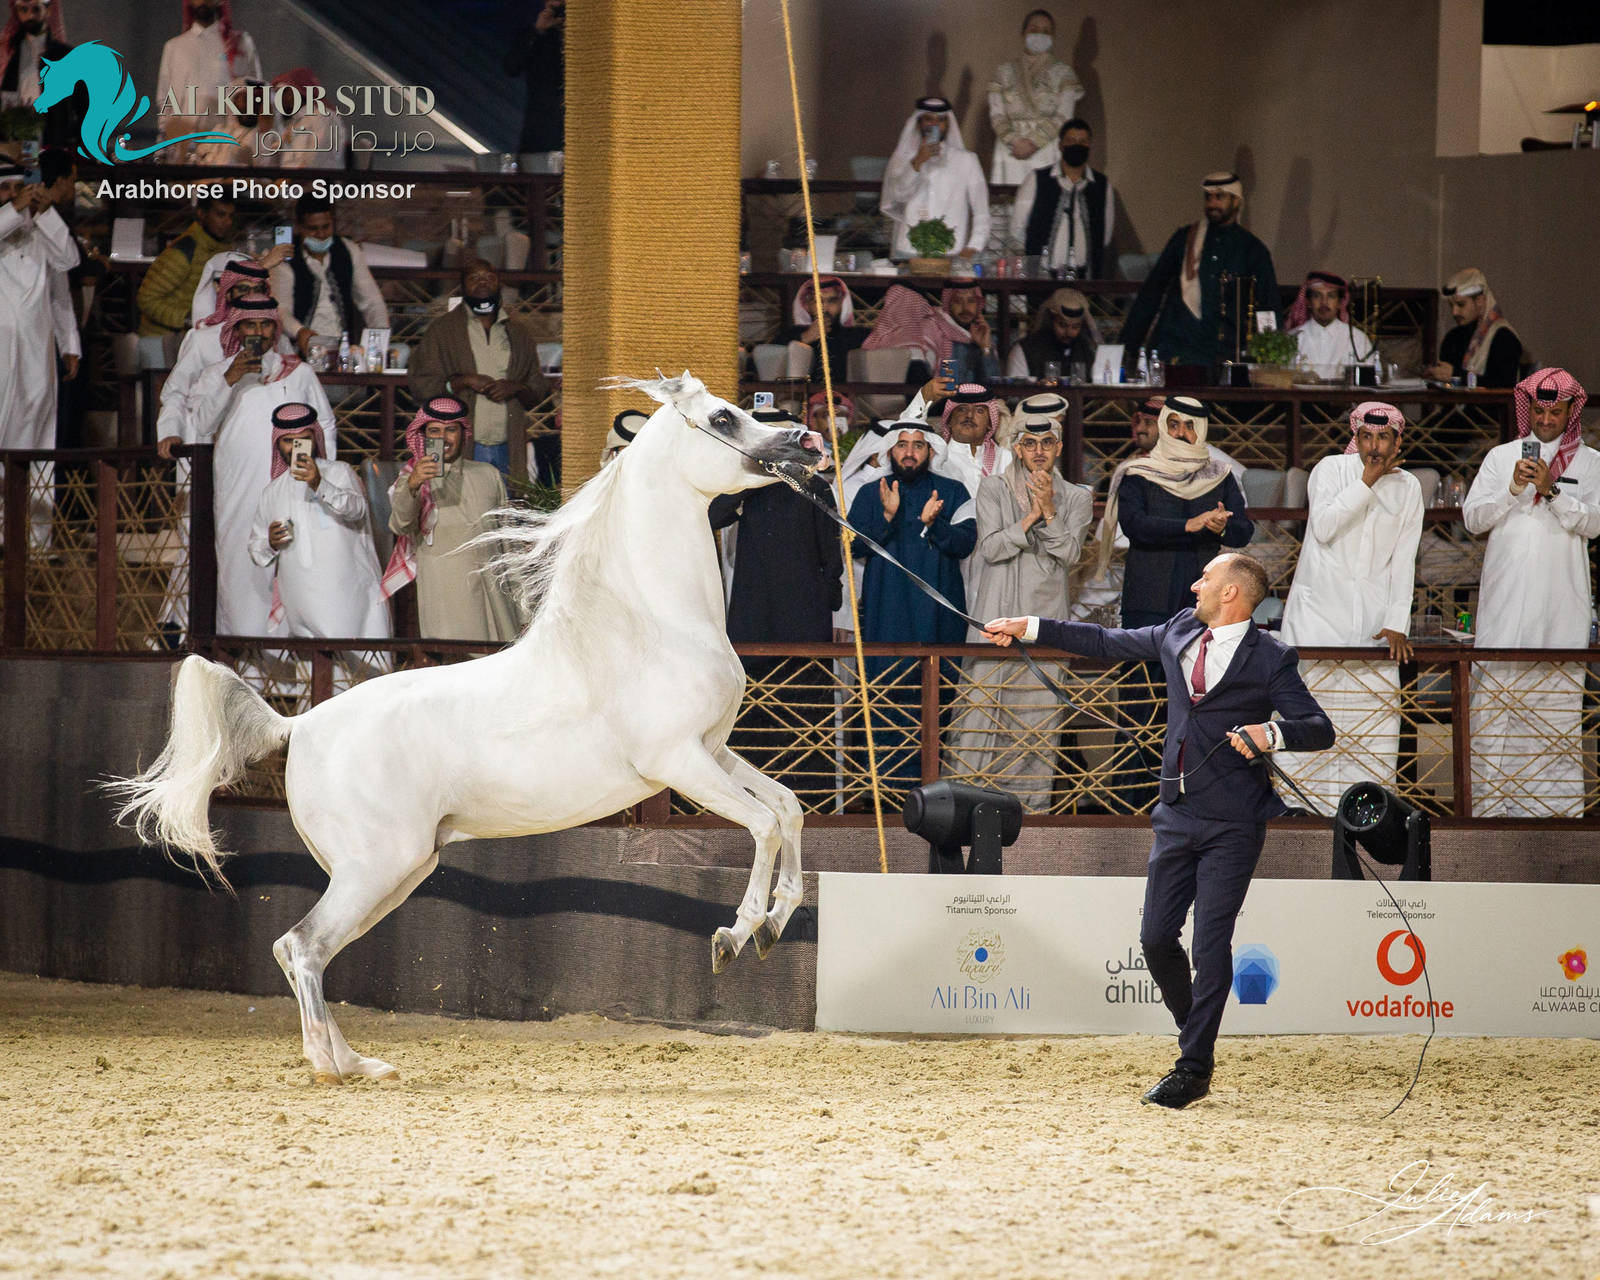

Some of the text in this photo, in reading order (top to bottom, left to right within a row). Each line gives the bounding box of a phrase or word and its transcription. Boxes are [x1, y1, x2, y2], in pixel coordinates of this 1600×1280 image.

[945, 905, 1018, 915] Titanium Sponsor
[1367, 910, 1436, 920] Telecom Sponsor
[931, 985, 1030, 1010] Ali Bin Ali
[1105, 979, 1164, 1004] ahlib
[1346, 994, 1455, 1018] vodafone
[965, 1015, 995, 1025] LUXURY
